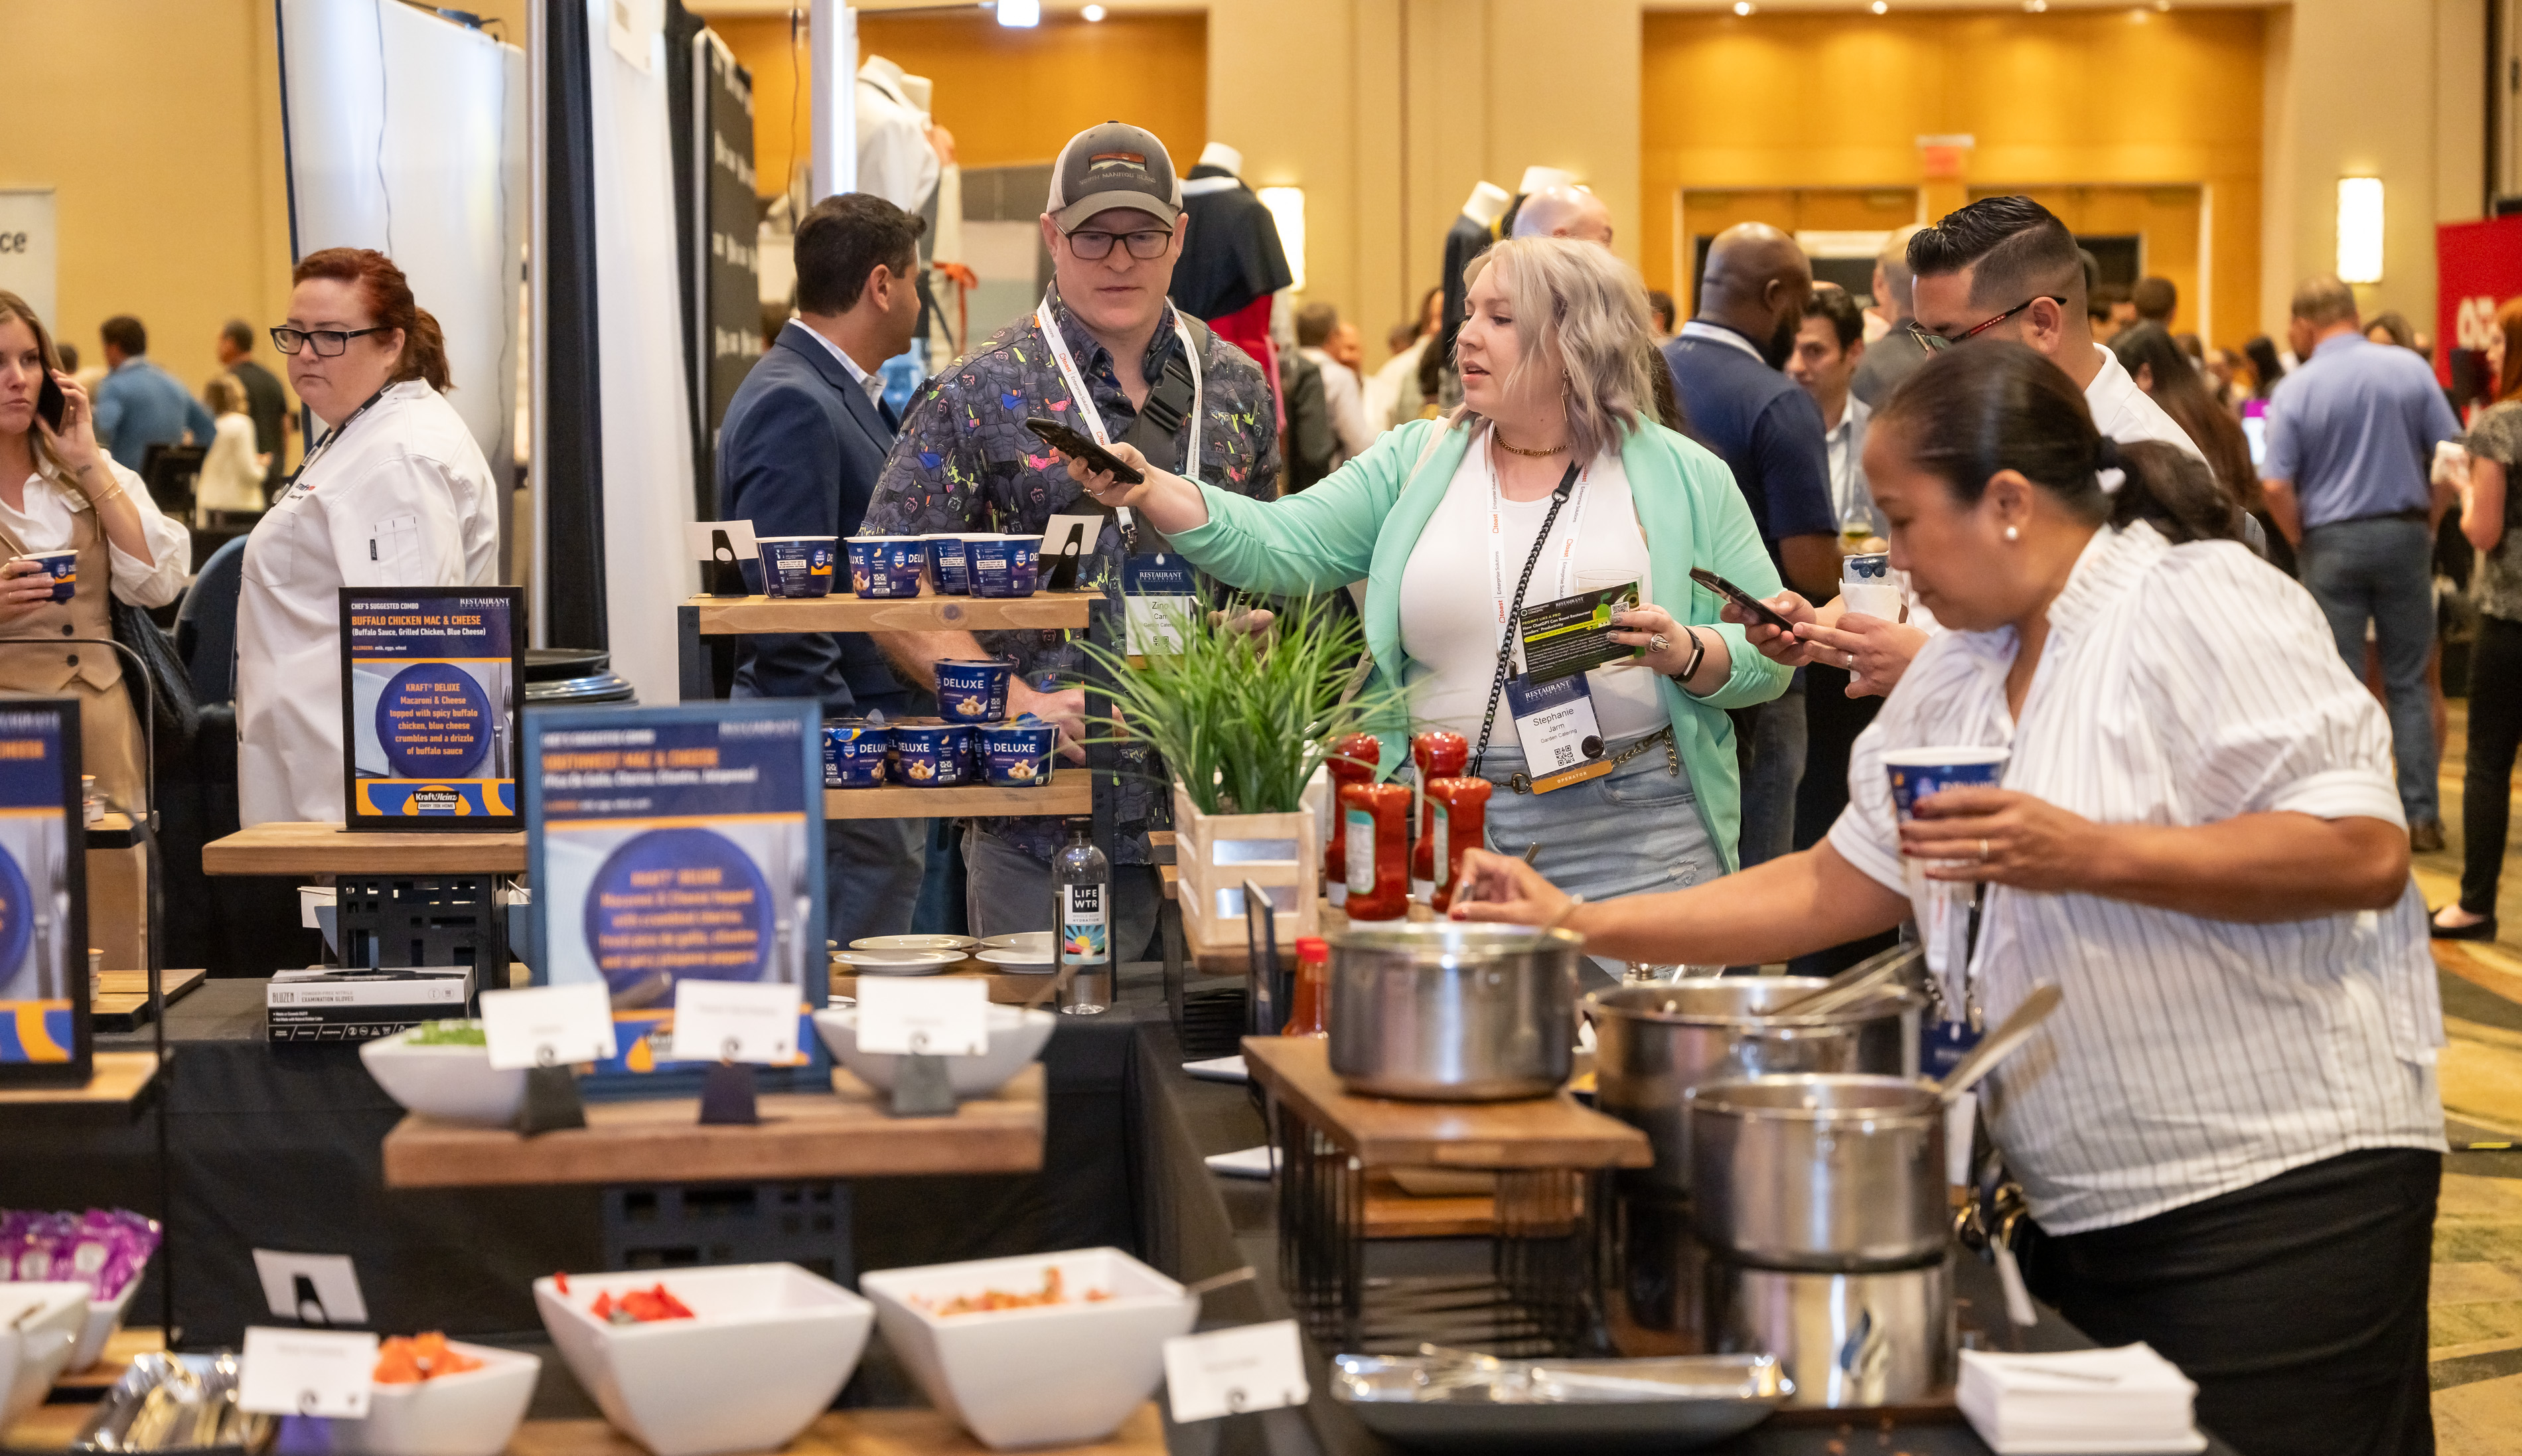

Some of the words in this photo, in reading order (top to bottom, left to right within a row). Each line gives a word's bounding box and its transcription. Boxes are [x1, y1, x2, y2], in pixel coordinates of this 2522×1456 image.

[1079, 175, 1100, 186] NORTH
[1136, 174, 1156, 183] ISLAND
[1045, 321, 1055, 338] Solutions
[1062, 356, 1072, 373] toast
[1071, 376, 1082, 397] Enterprise
[1080, 396, 1092, 415] Solutions
[1576, 486, 1586, 507] Enterprise
[352, 616, 386, 626] BUFFALO
[388, 616, 422, 625] CHICKEN
[424, 616, 441, 625] MAC
[443, 616, 449, 625] &
[451, 615, 481, 625] CHEESE
[1541, 622, 1564, 631] Productivity
[944, 678, 984, 689] DELUXE
[1525, 680, 1570, 699] RESTAURANT
[390, 709, 413, 719] topped
[433, 709, 451, 719] spicy
[1533, 707, 1574, 727] Stephanie
[398, 722, 427, 731] chicken,
[1548, 723, 1565, 733] Jarm
[1540, 735, 1558, 743] Garden
[1558, 729, 1578, 739] Catering
[898, 743, 930, 753] DELUXE
[994, 743, 1036, 753] DELUXE
[1557, 772, 1588, 784] OPERATOR
[415, 792, 457, 801] KraftHeinz
[1075, 889, 1097, 898] LIFE
[1075, 900, 1097, 909] WTR
